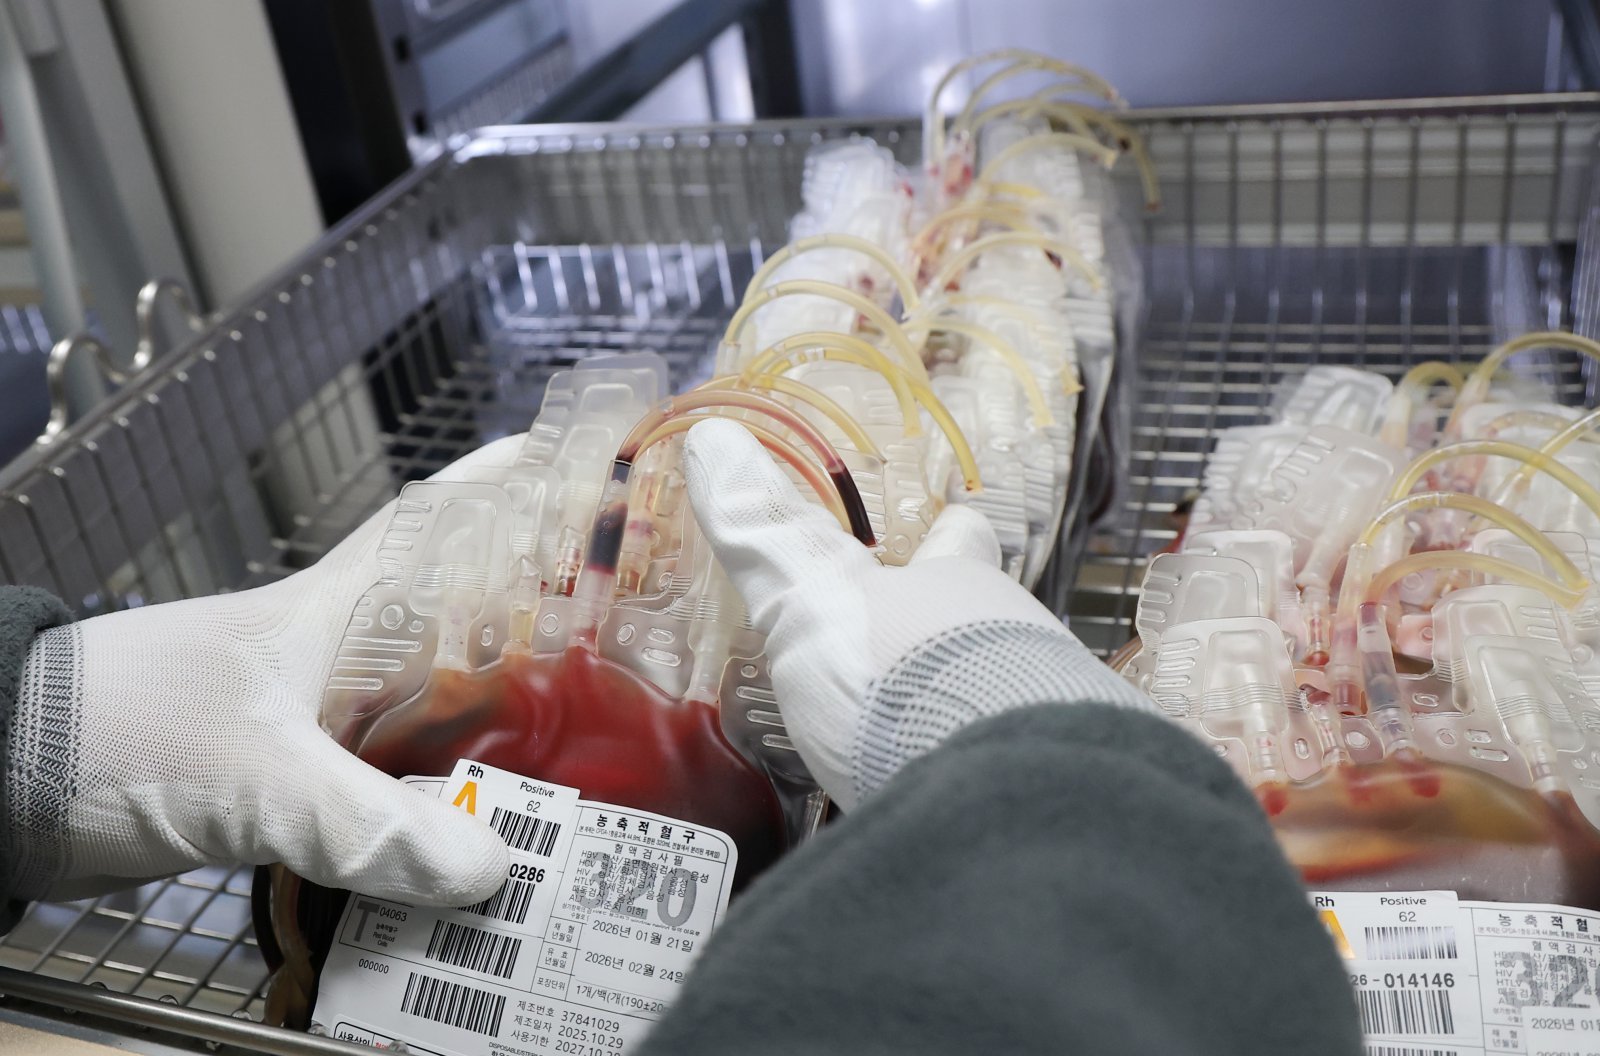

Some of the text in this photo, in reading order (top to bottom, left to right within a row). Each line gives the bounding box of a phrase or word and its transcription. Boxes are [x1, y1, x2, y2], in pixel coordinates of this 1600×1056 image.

[467, 765, 484, 779] Rh
[520, 781, 555, 798] Positive
[452, 780, 478, 816] A
[526, 800, 541, 813] 62
[578, 858, 597, 868] HCV
[581, 850, 598, 859] HBV
[690, 871, 710, 884] 음성
[509, 863, 546, 883] 0286
[576, 867, 591, 876] HIV
[573, 876, 595, 887] HTLV
[568, 894, 584, 903] ALT
[1315, 896, 1335, 907] Rh
[1380, 897, 1427, 906] Positive
[354, 900, 408, 942] T 04063
[1399, 911, 1417, 923] 62
[592, 919, 631, 939] 2026년
[635, 929, 662, 946] 01월
[666, 937, 694, 953] 21일
[358, 958, 389, 974] 000000
[584, 951, 624, 971] 2026년
[628, 961, 655, 977] 02월
[1496, 969, 1513, 977] HIV
[536, 977, 566, 991] 포장단위
[1384, 973, 1455, 988] 014146
[1496, 979, 1521, 987] HTLV
[576, 985, 667, 1014] 1개/백(개(190±20
[516, 1000, 620, 1033] 제조번호 37841029
[1531, 1017, 1576, 1031] 2026년
[510, 1029, 549, 1048] 사용기한
[513, 1014, 624, 1049] 제조일자 2025.10.29
